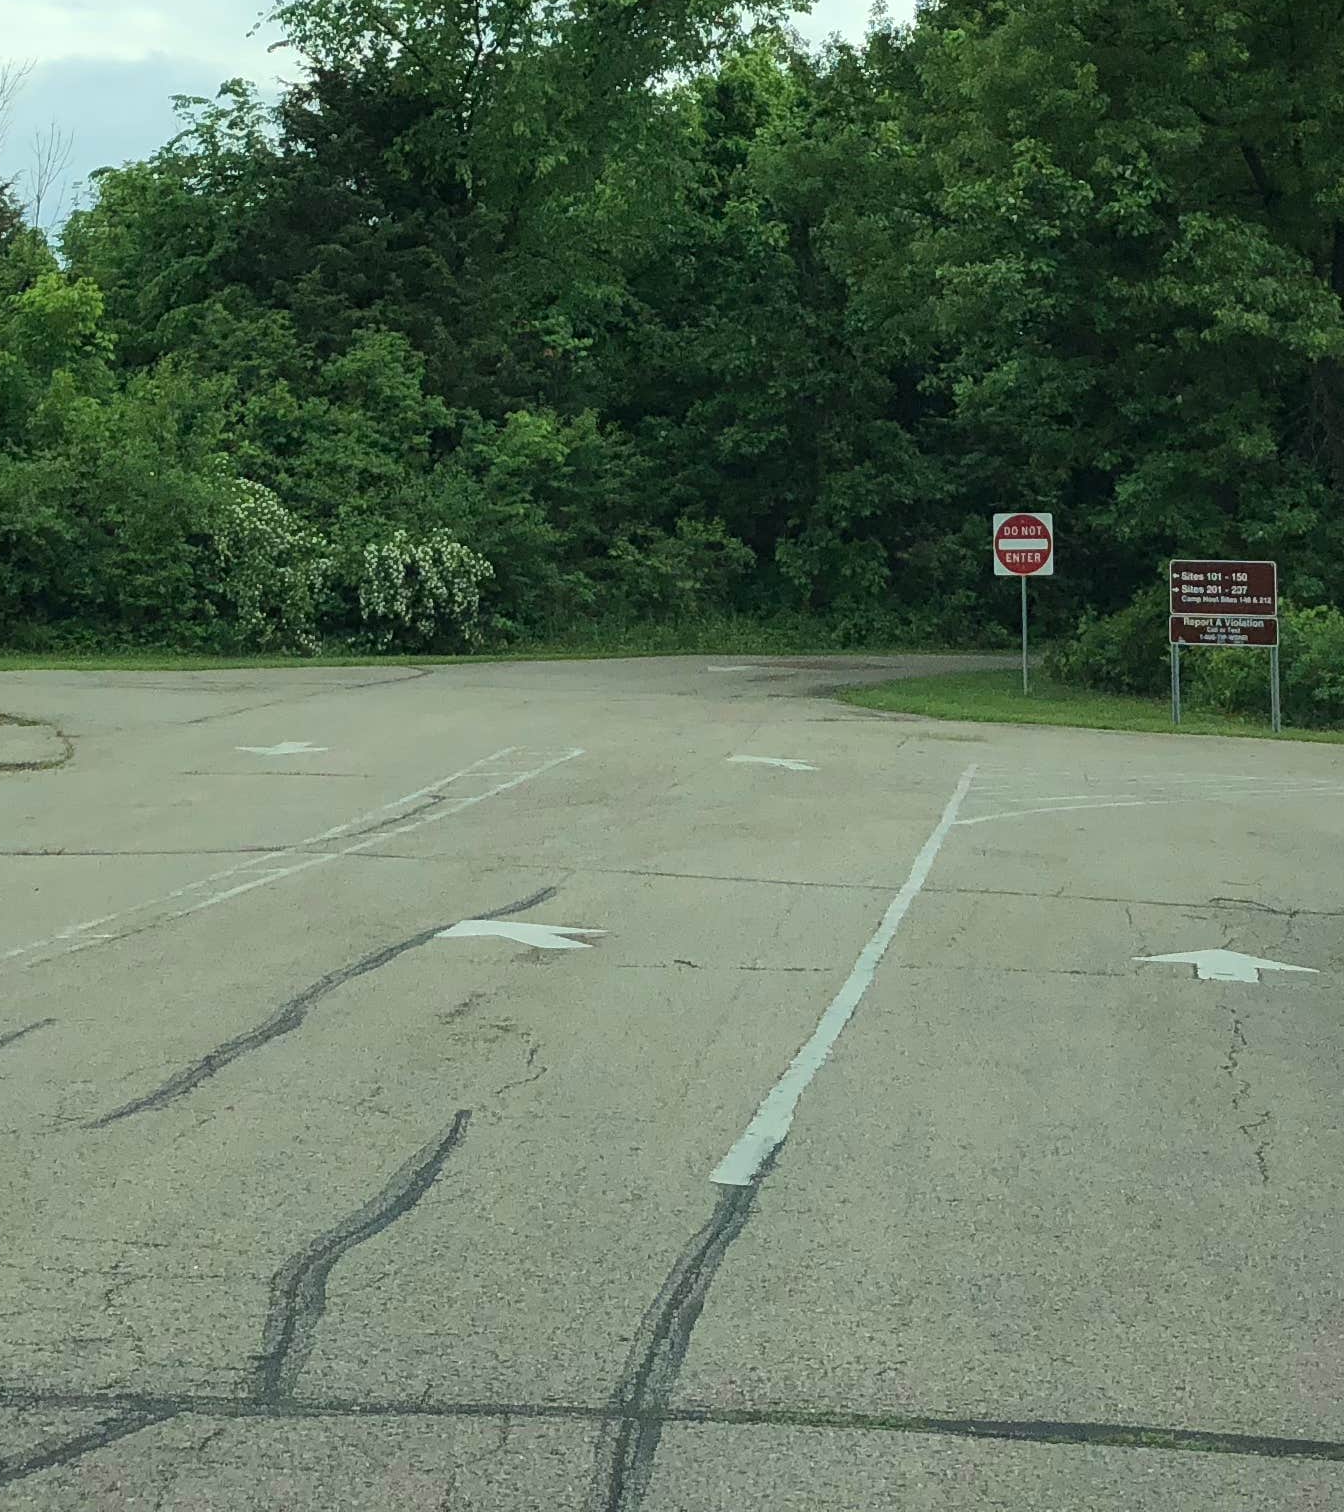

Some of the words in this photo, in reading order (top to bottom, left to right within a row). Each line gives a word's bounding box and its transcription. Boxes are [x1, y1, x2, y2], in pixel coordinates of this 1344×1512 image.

[1004, 527, 1018, 535] DO
[1022, 526, 1041, 535] NOT
[1006, 553, 1040, 562] ENTER
[1181, 571, 1204, 581] Sites
[1206, 572, 1222, 581] 101
[1231, 572, 1248, 582] 150
[1181, 584, 1204, 594] Sites
[1206, 584, 1222, 594] 201
[1184, 617, 1213, 627] Report
[1224, 618, 1264, 628] Violation
